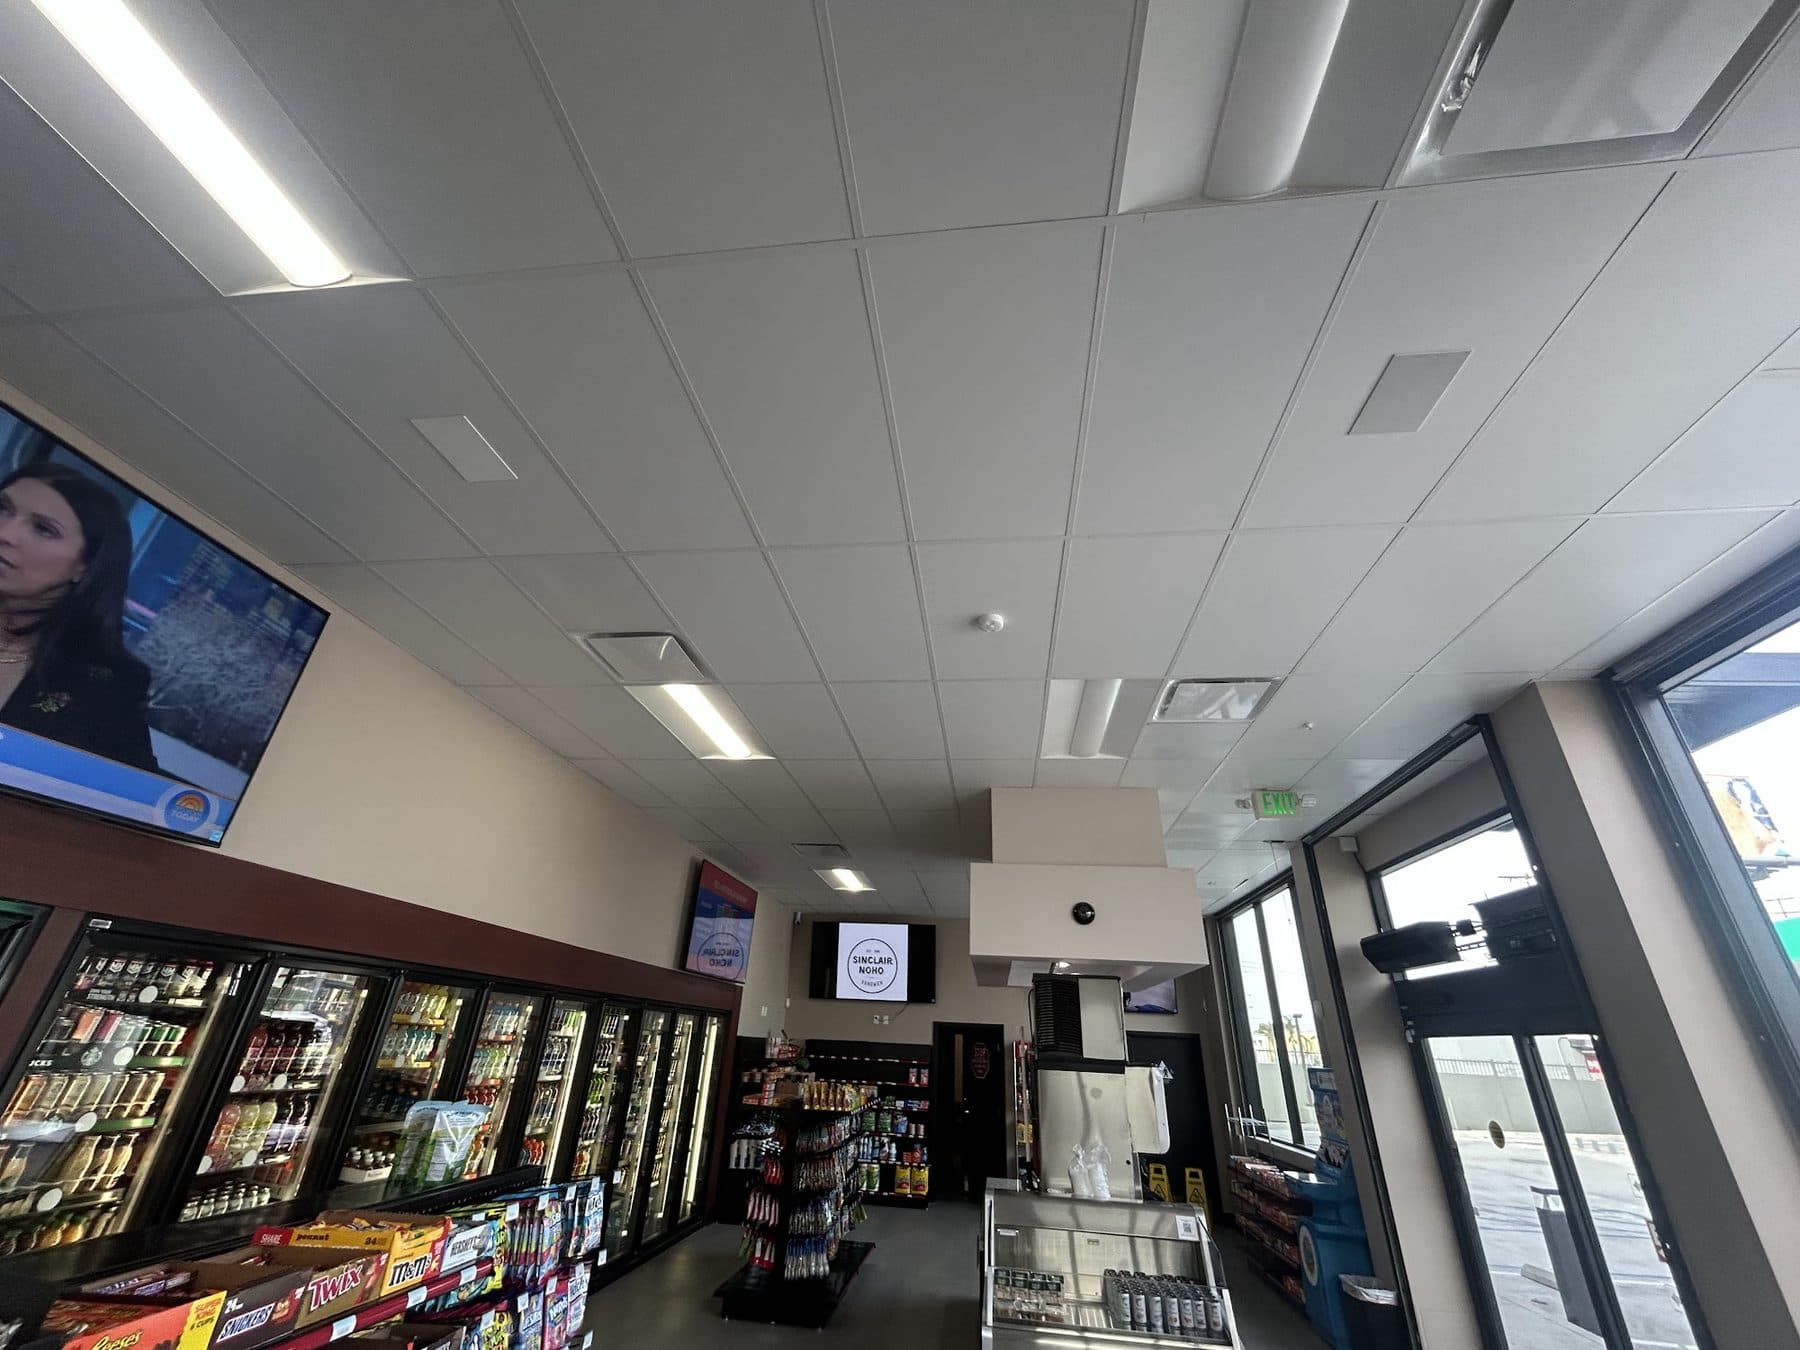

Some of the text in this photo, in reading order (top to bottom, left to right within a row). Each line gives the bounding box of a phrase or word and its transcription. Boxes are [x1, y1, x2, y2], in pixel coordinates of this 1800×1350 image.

[1262, 790, 1295, 816] EXIT
[853, 955, 894, 966] SINCLAIR
[858, 966, 884, 975] NOHO
[296, 1233, 330, 1241] peanut
[219, 1307, 273, 1341] SNICKERS
